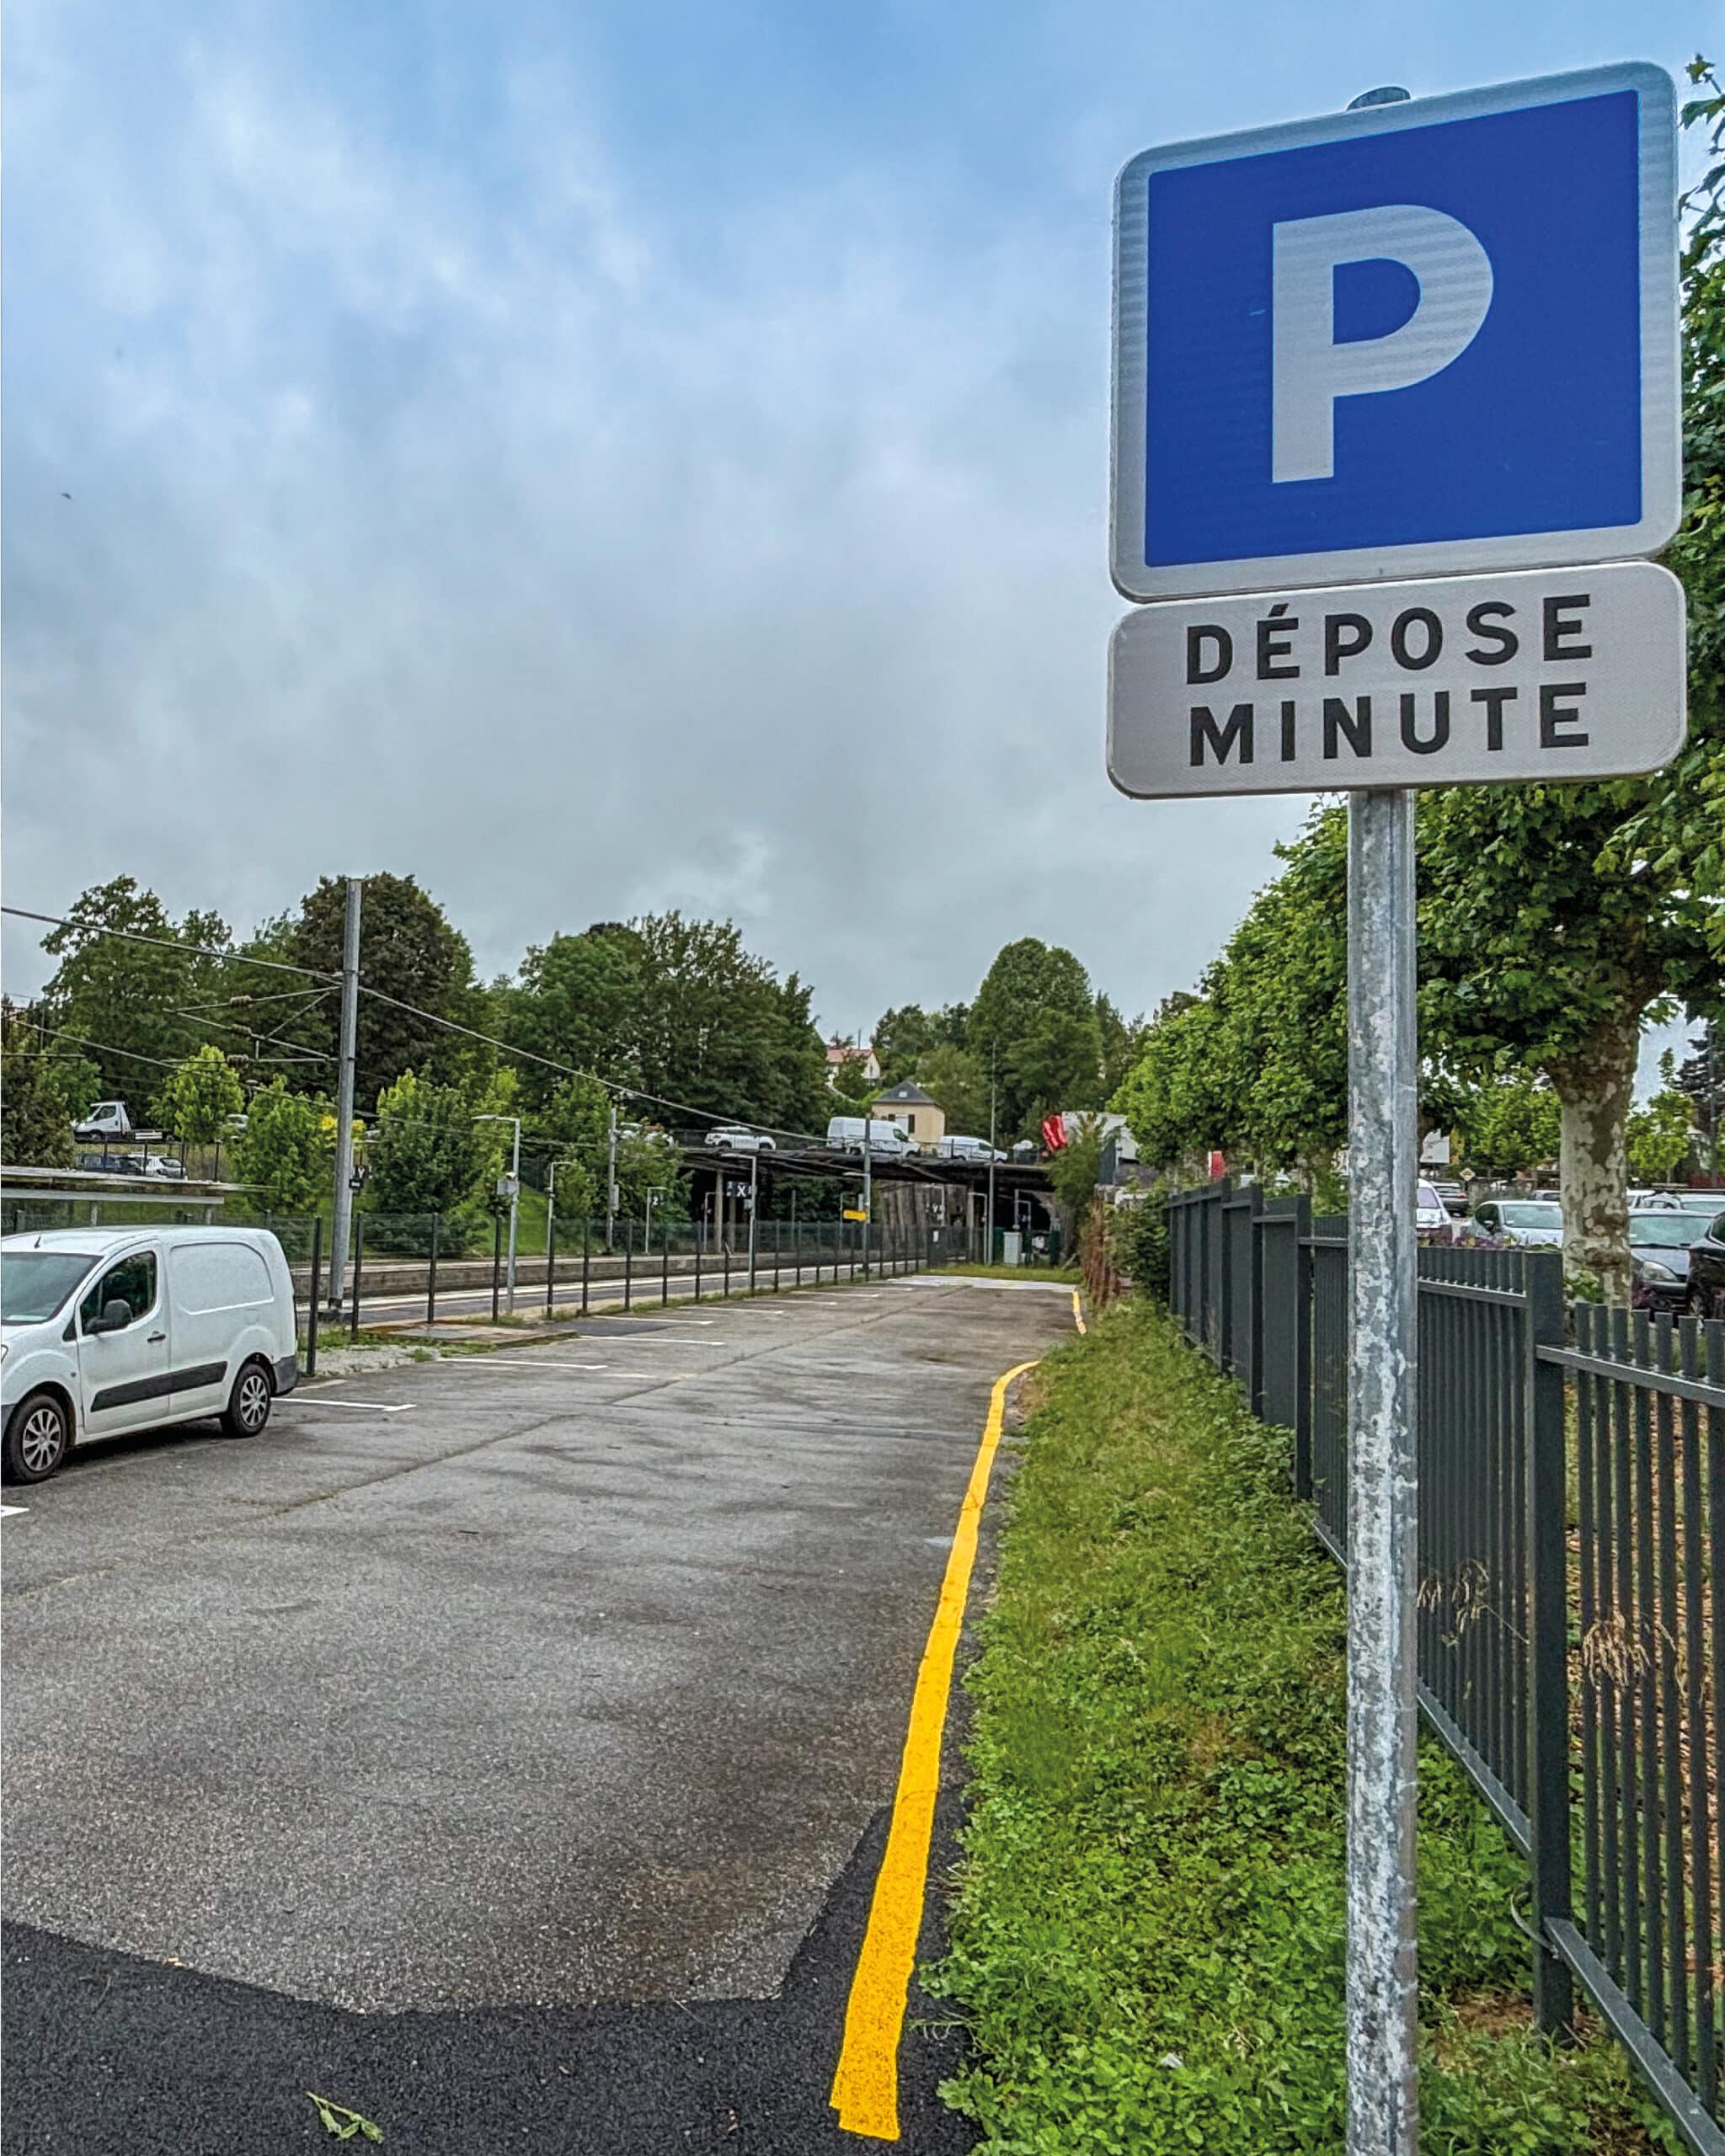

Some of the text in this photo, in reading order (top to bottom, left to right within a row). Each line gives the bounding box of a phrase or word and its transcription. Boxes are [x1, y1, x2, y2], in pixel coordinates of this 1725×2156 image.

[1273, 205, 1494, 483] P
[1187, 595, 1592, 685] DÉPOSE
[1190, 682, 1589, 766] MINUTE
